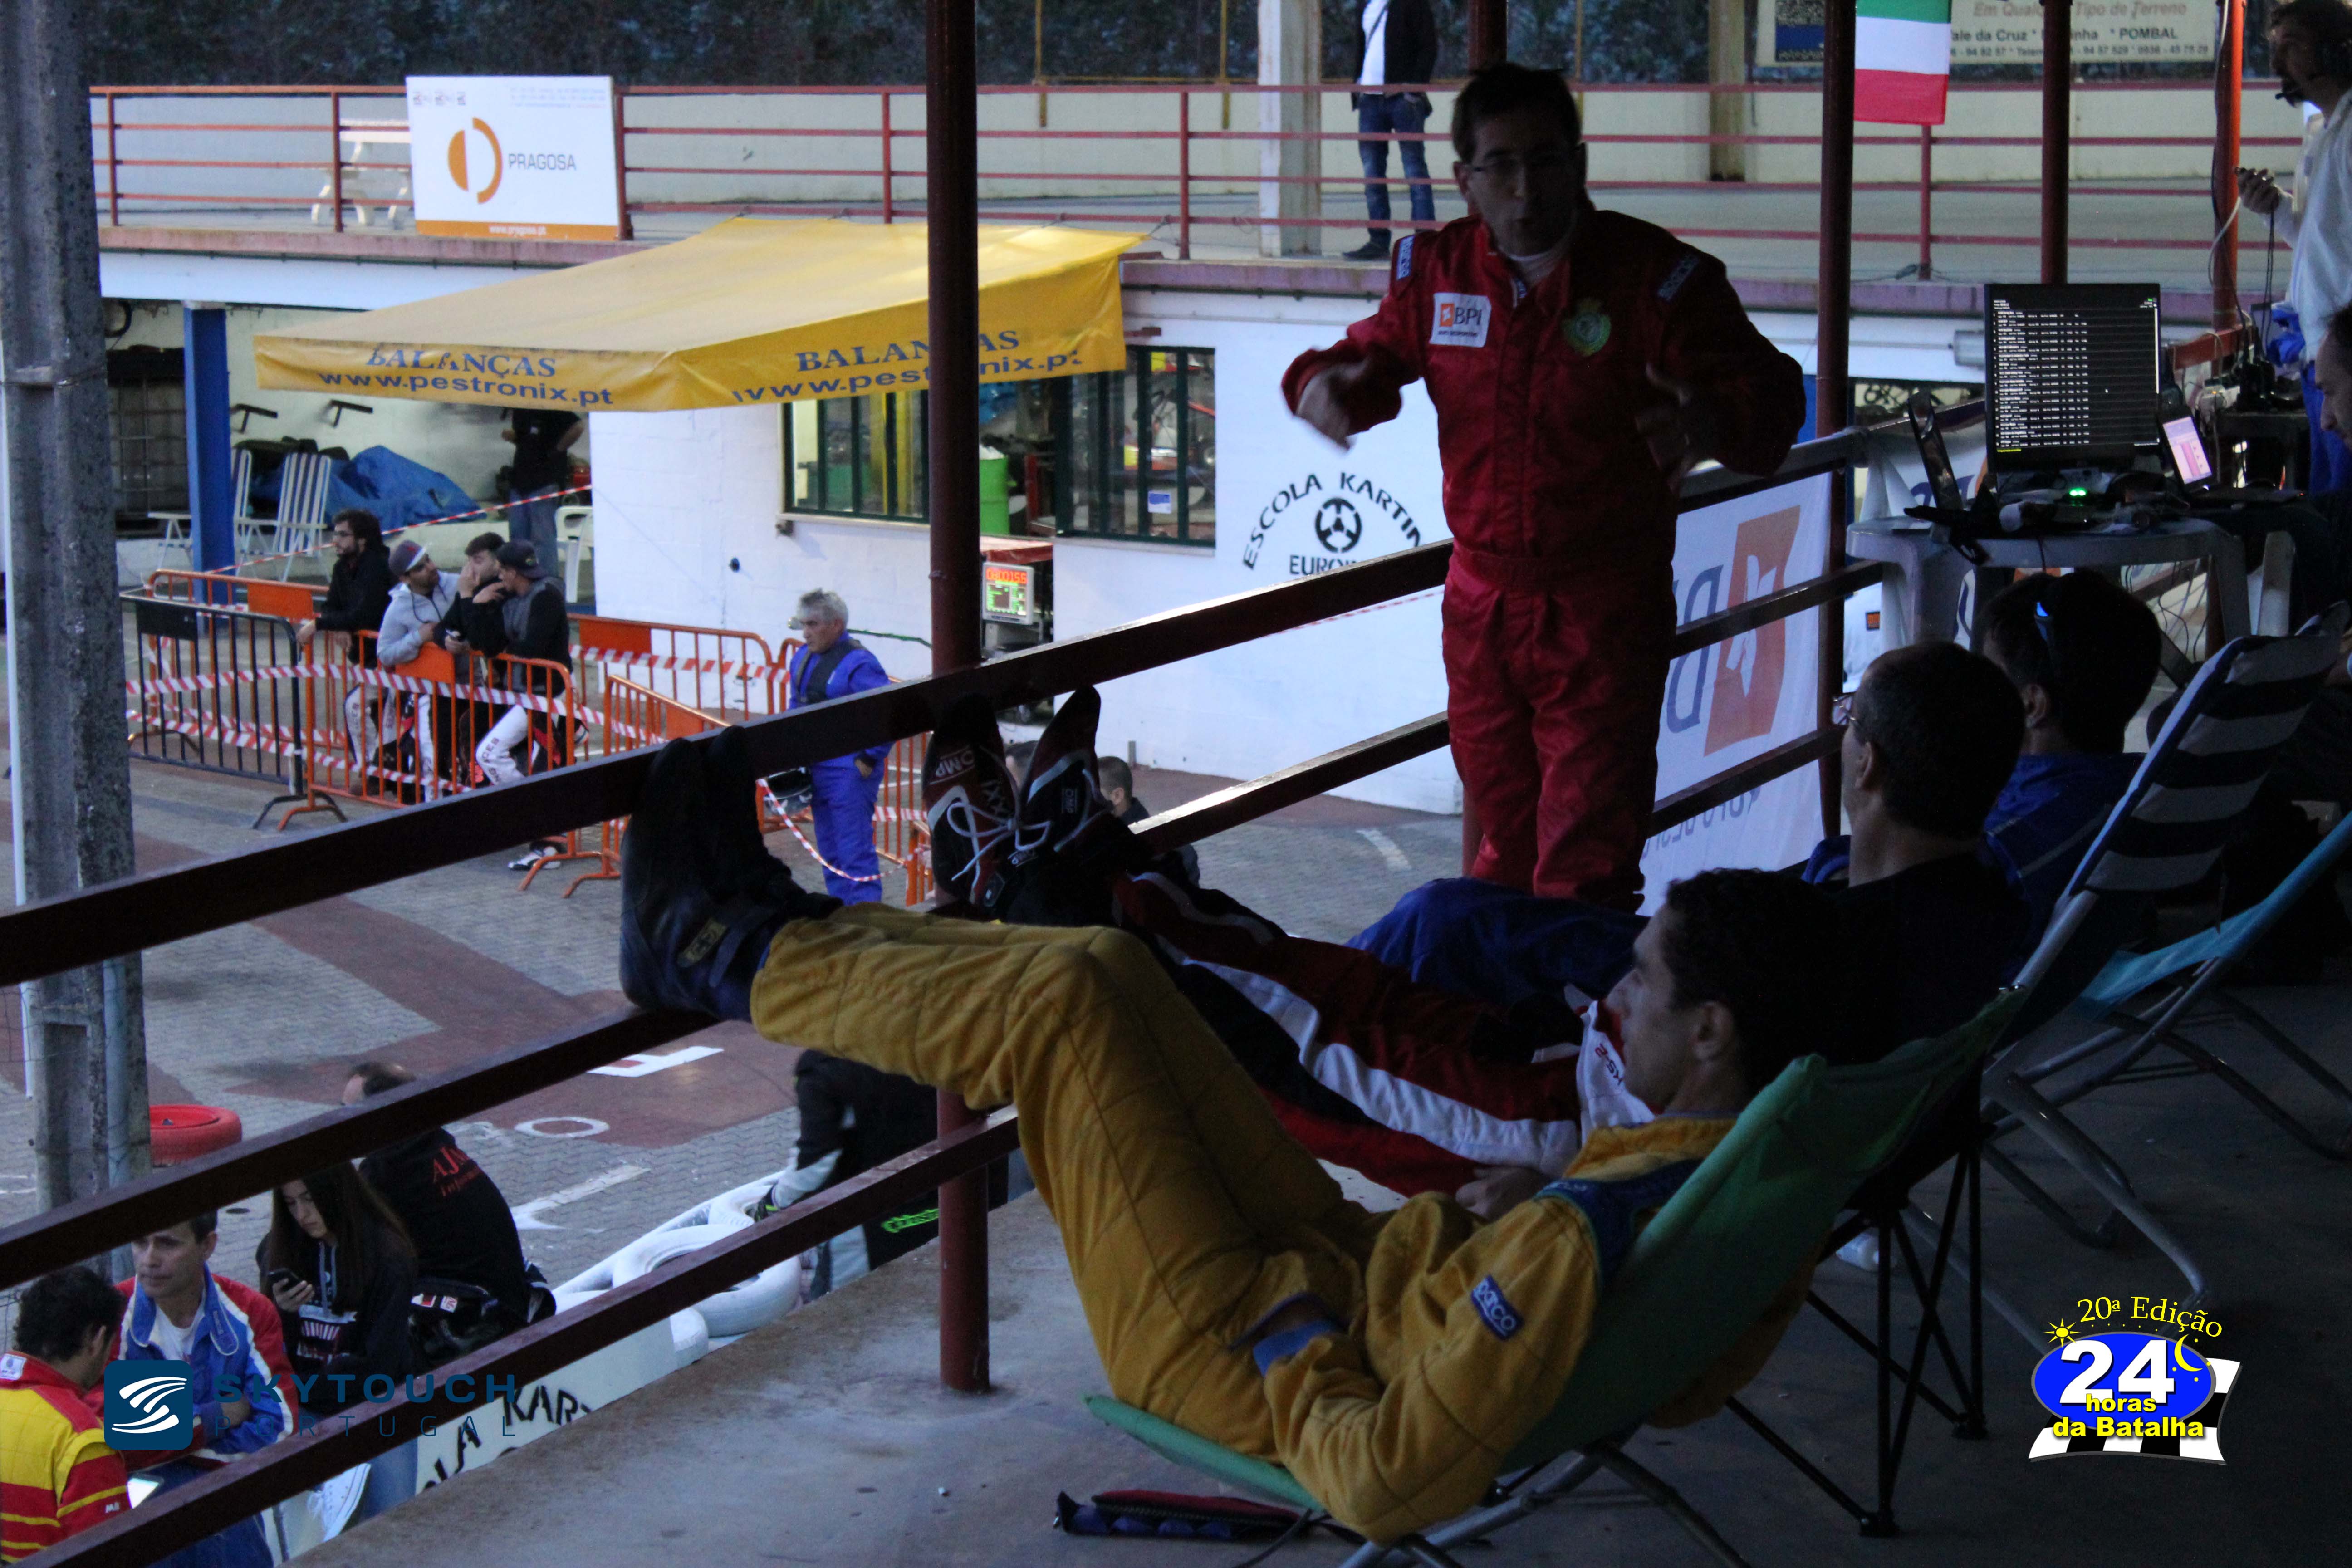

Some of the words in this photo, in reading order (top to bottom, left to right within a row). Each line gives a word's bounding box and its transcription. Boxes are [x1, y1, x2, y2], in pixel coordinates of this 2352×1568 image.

[1950, 29, 1971, 41] ale
[1975, 29, 1991, 41] da
[1996, 29, 2028, 41] Cruz
[2119, 27, 2177, 39] POMBAL
[508, 153, 577, 171] PRAGOSA
[1454, 307, 1482, 325] BPI
[795, 330, 1019, 372] BALANAS
[318, 372, 614, 407] www.pestronix.pt
[731, 348, 1083, 403] www.pestnix.pt
[1242, 473, 1323, 571] ESCOLA
[1340, 472, 1421, 547] KARTIN
